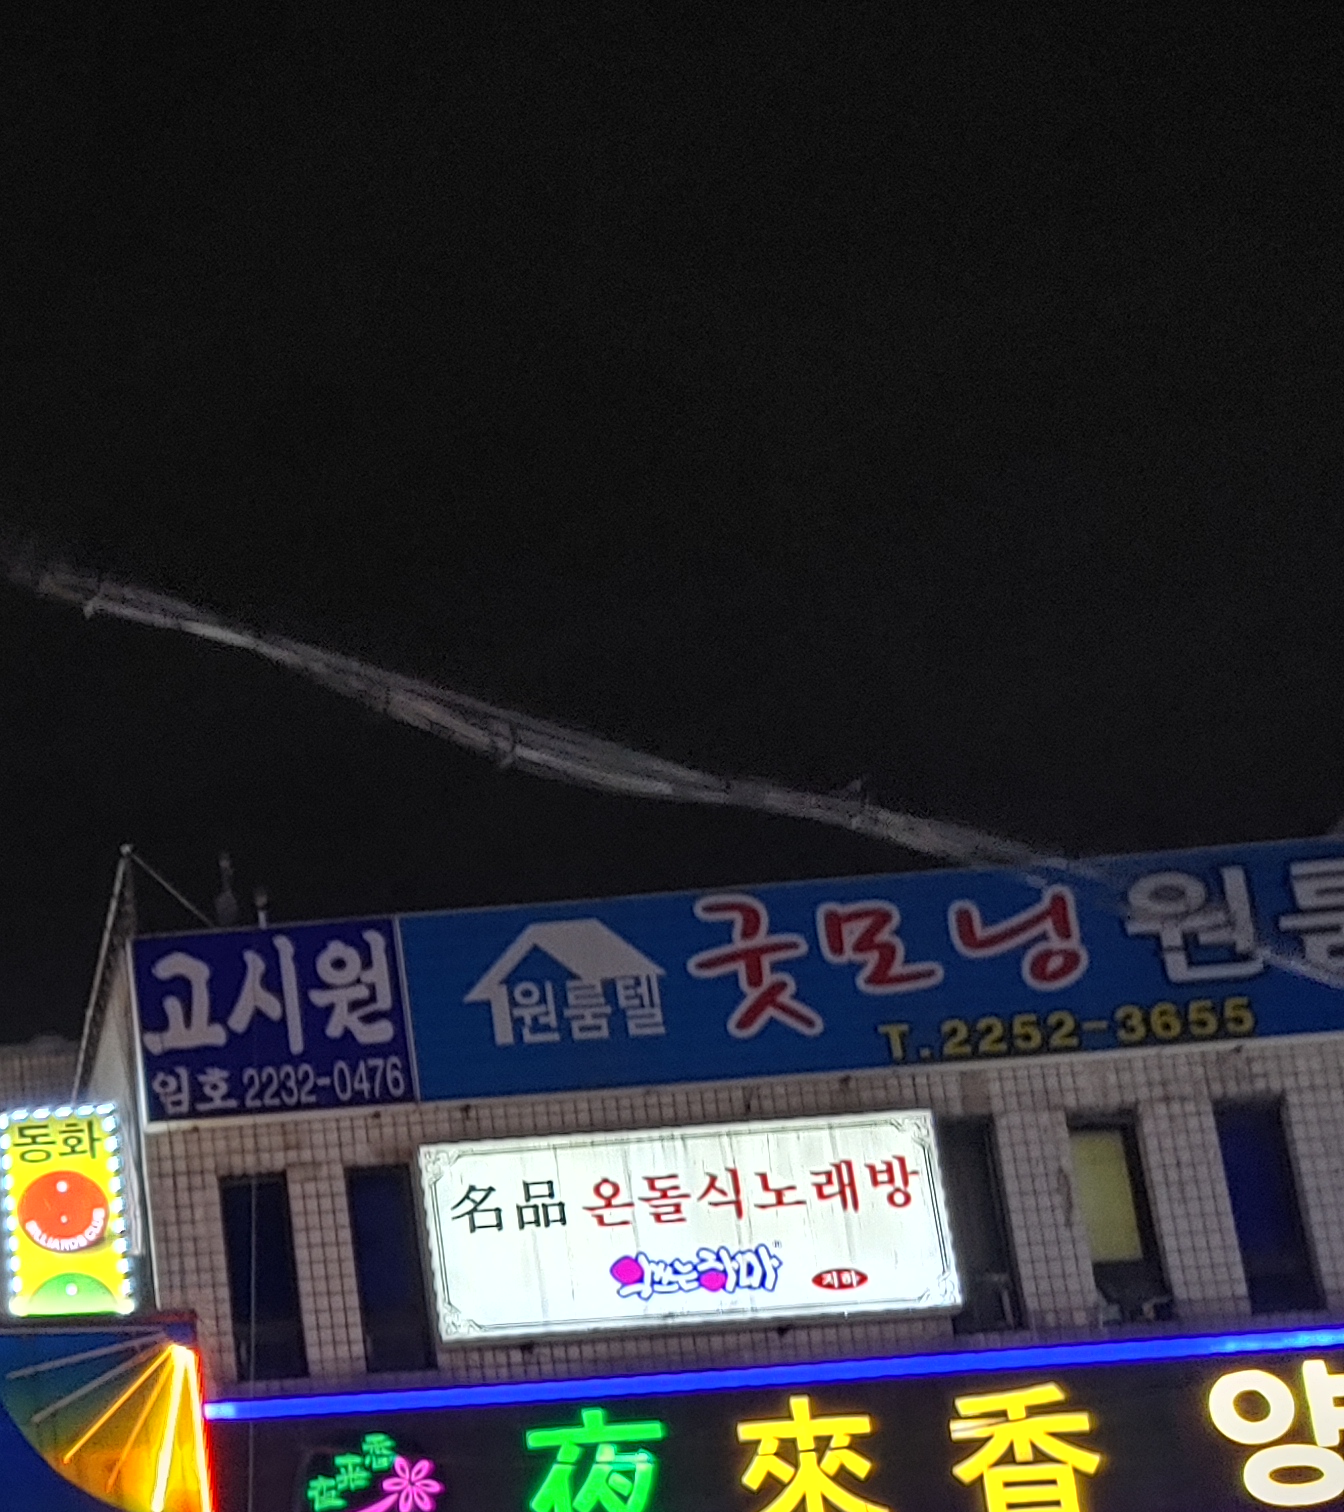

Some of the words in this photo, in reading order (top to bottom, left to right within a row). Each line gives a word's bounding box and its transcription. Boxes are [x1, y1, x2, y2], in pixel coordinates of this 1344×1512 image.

[142, 928, 396, 1056] 고시원
[687, 884, 1089, 1039] 굿모닝
[512, 972, 666, 1045] 원룸텔
[242, 1055, 405, 1106] 2232-0476
[12, 1119, 103, 1164] 동화
[450, 1180, 567, 1233] 名品
[583, 1154, 920, 1229] 온돌식노래방
[821, 1270, 860, 1289] 지하
